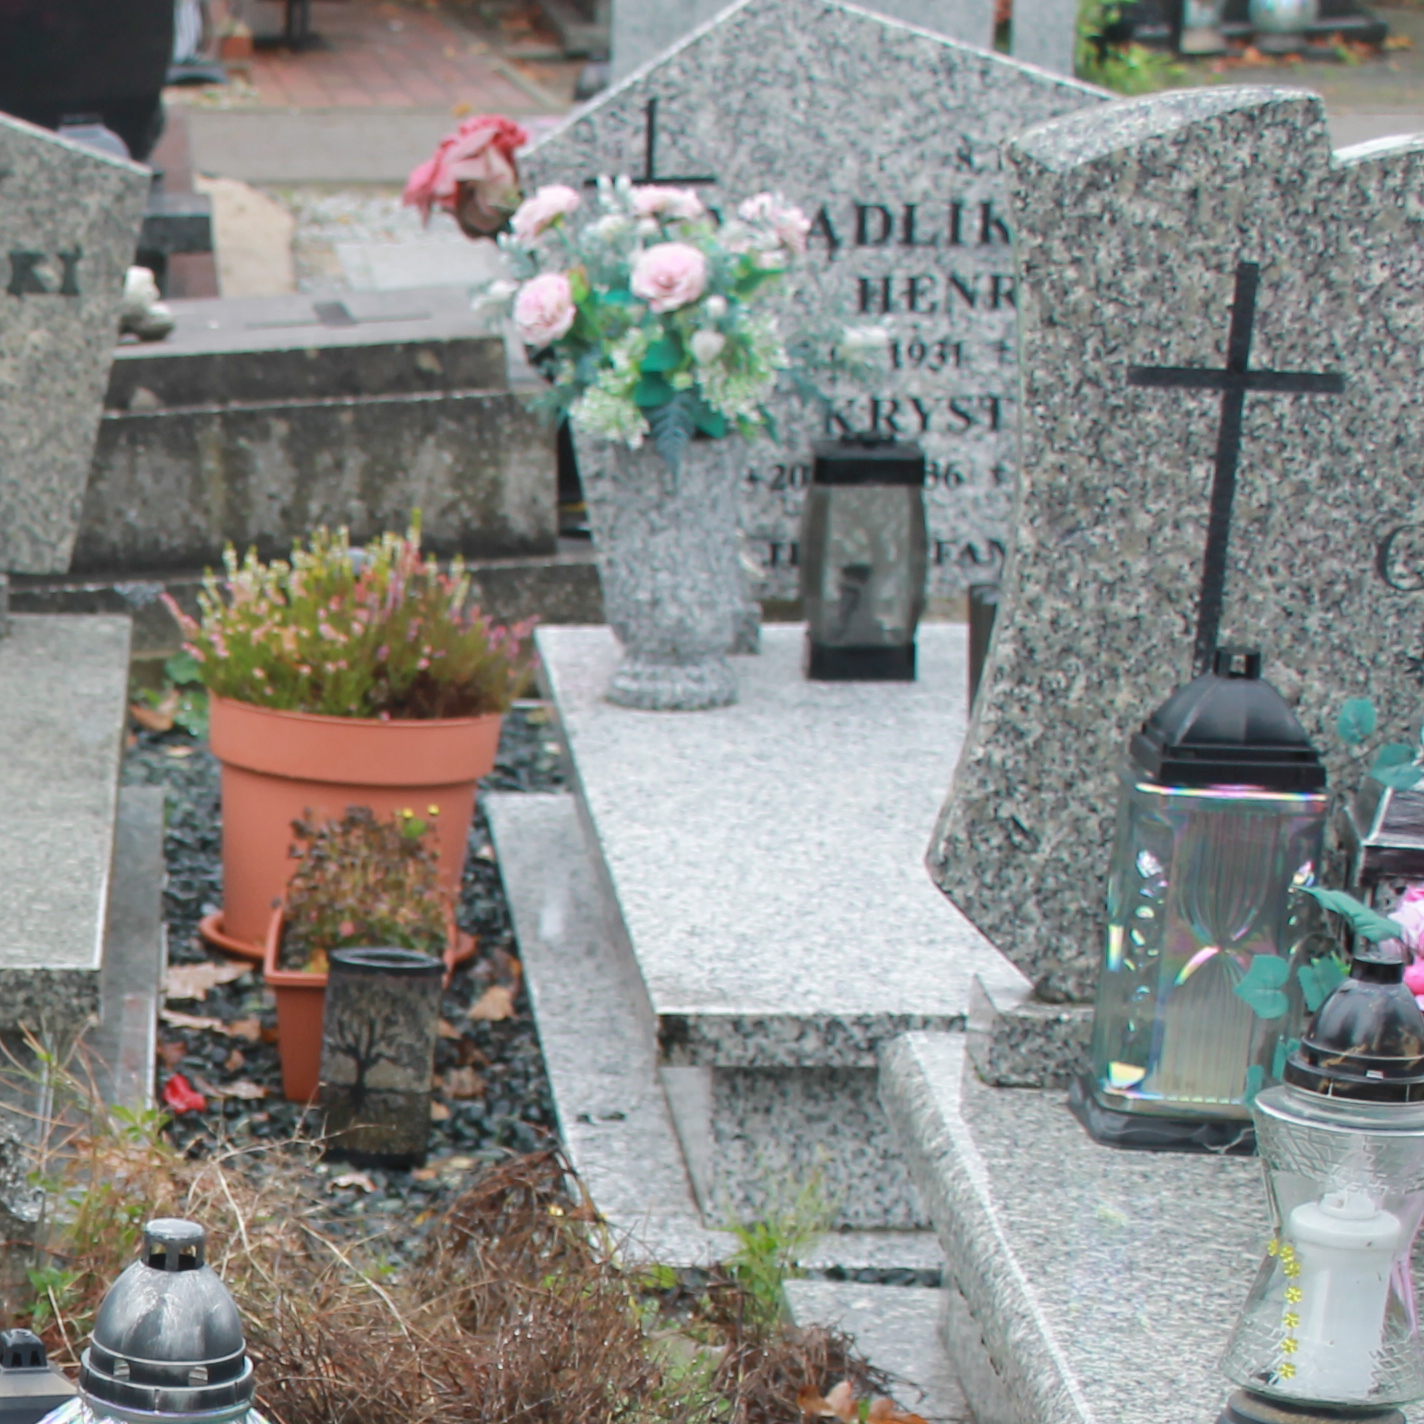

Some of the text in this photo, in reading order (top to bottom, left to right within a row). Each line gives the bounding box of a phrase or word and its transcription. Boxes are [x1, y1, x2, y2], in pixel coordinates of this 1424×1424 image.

[807, 203, 1012, 262] ĄDLIK
[857, 273, 1016, 315] HENR
[824, 396, 1014, 440] KRYST
